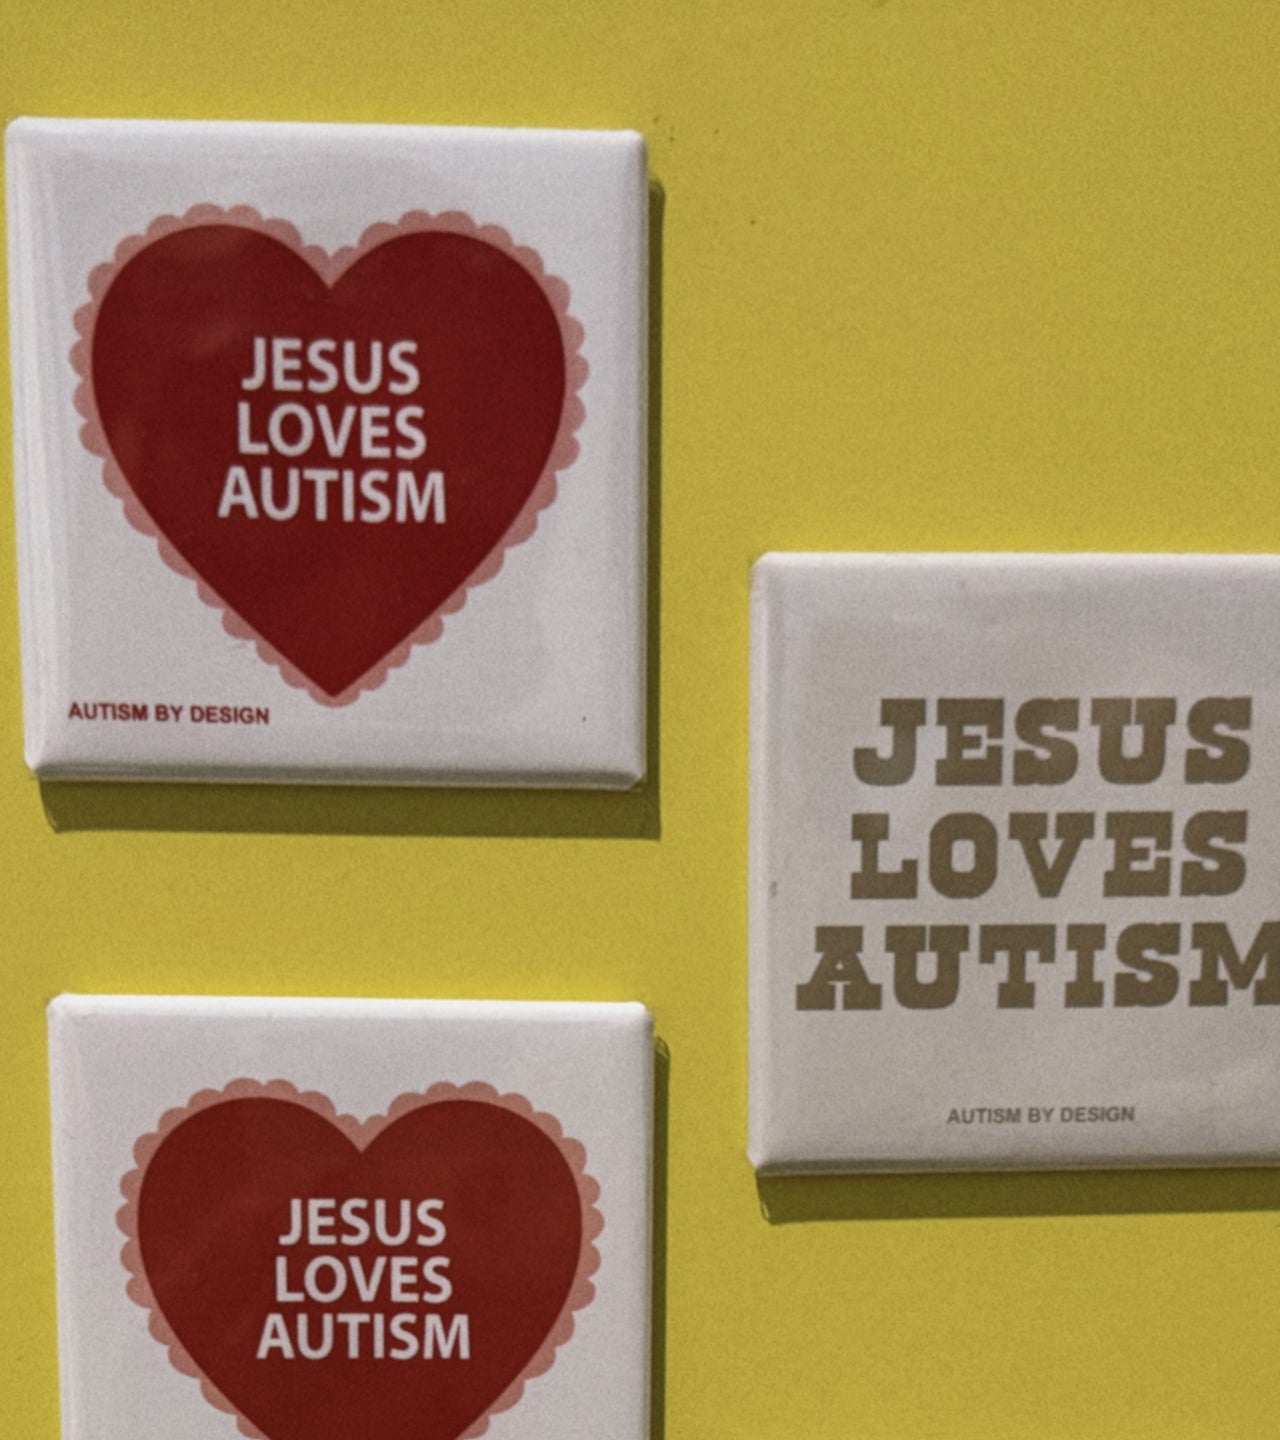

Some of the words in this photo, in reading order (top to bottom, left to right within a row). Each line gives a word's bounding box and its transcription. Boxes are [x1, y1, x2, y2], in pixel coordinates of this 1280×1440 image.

[242, 337, 420, 395] JESUS
[237, 402, 427, 459] LOVES
[218, 466, 446, 524] AUTISM
[69, 702, 149, 722] AUTISM
[155, 705, 184, 722] BY
[190, 705, 270, 725] DESIGN
[852, 696, 1252, 787] JESUS
[850, 810, 1249, 899] LOVES
[947, 1108, 1022, 1125] AUTISM
[1028, 1108, 1055, 1123] BY
[1060, 1106, 1135, 1123] DESIGN
[278, 1198, 447, 1247] JESUS
[275, 1255, 453, 1304] LOVES
[255, 1312, 471, 1360] AUTISM
